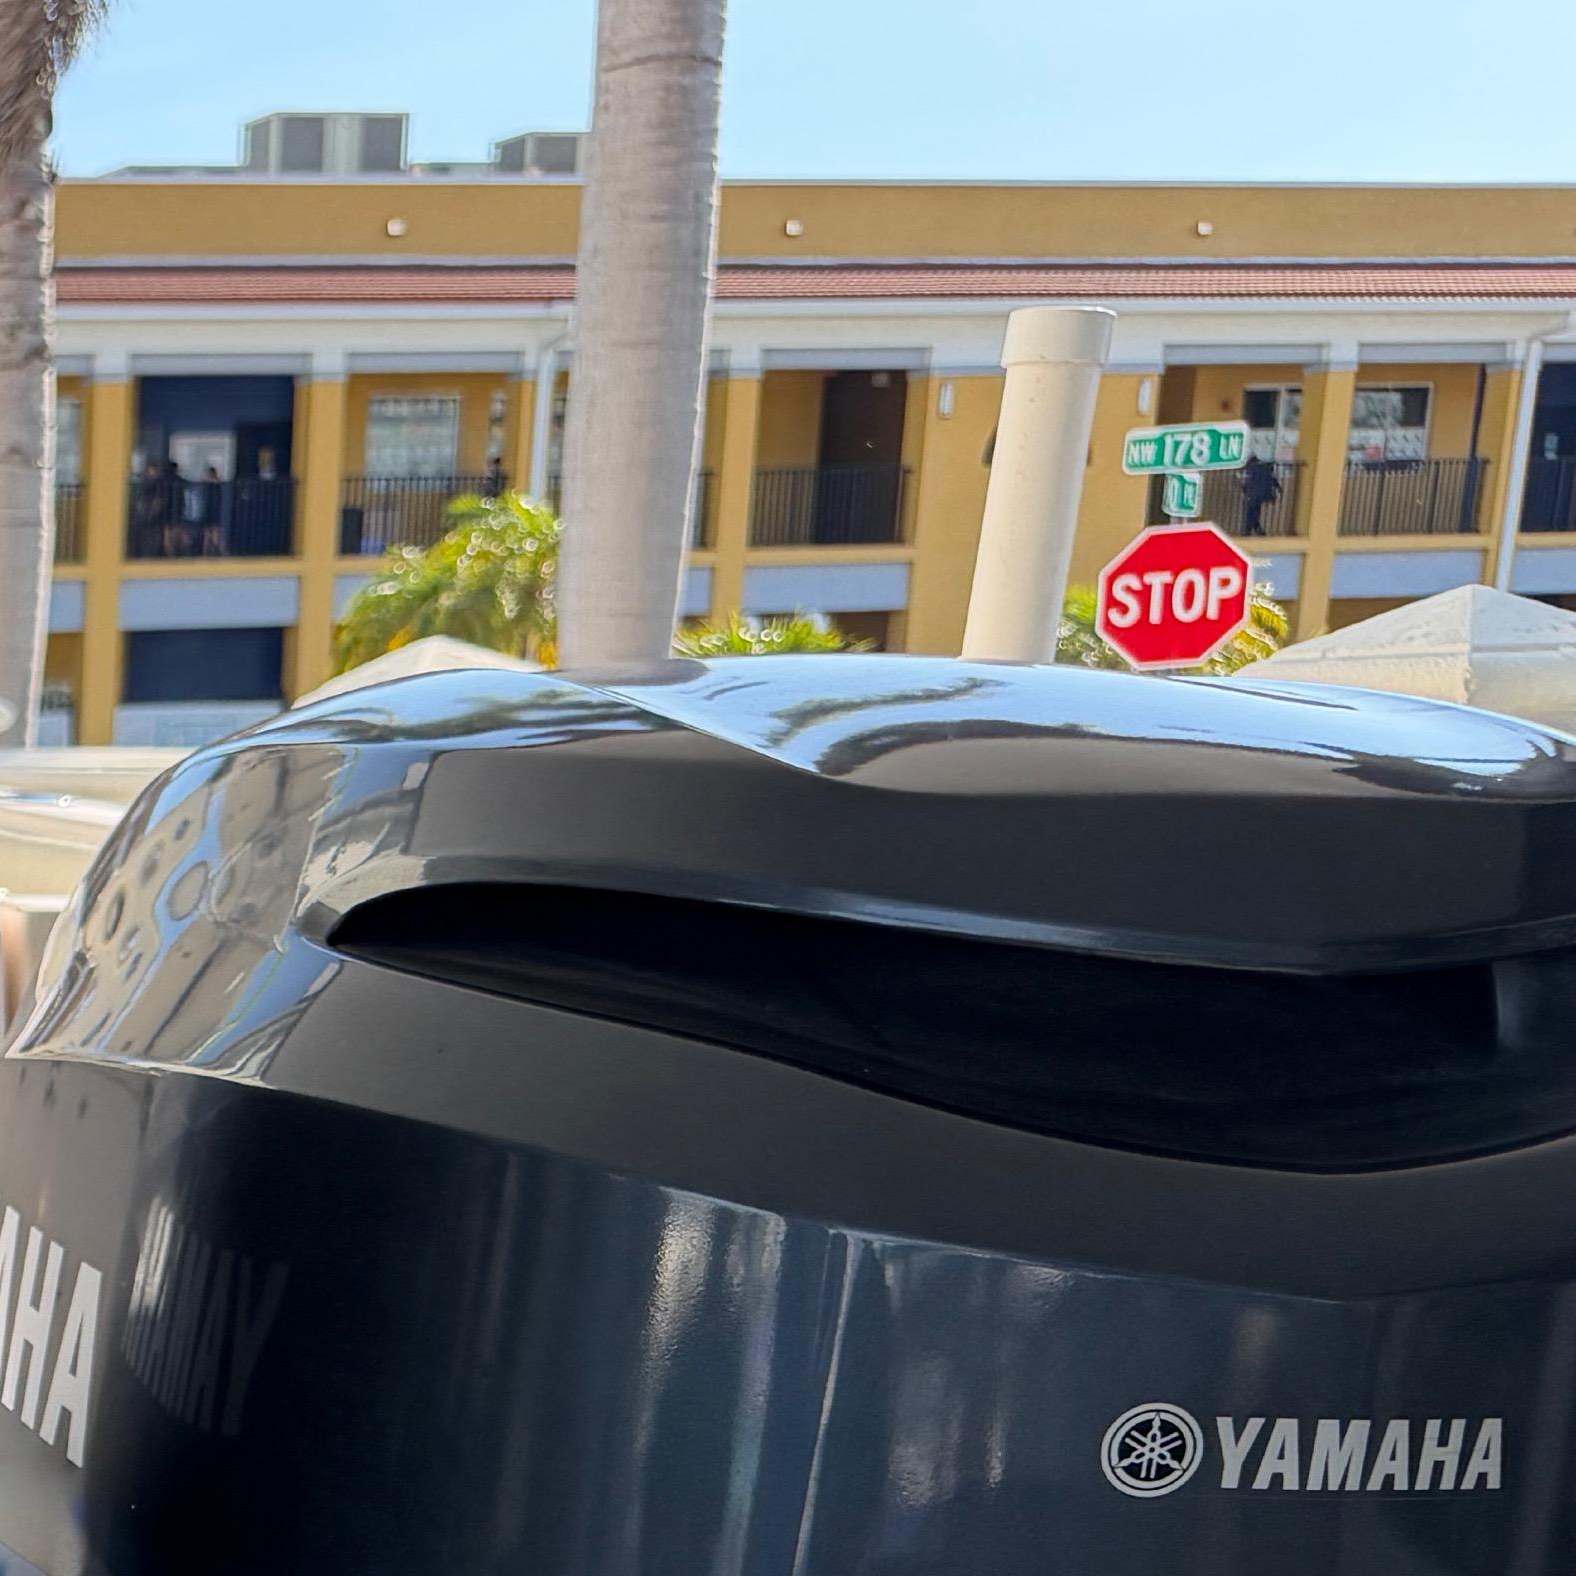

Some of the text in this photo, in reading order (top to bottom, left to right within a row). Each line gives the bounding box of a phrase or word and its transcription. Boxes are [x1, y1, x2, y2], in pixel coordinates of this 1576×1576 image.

[1127, 430, 1241, 467] NW 178 LN
[1107, 565, 1243, 629] STOP
[1215, 1415, 1504, 1491] YAMAHA
